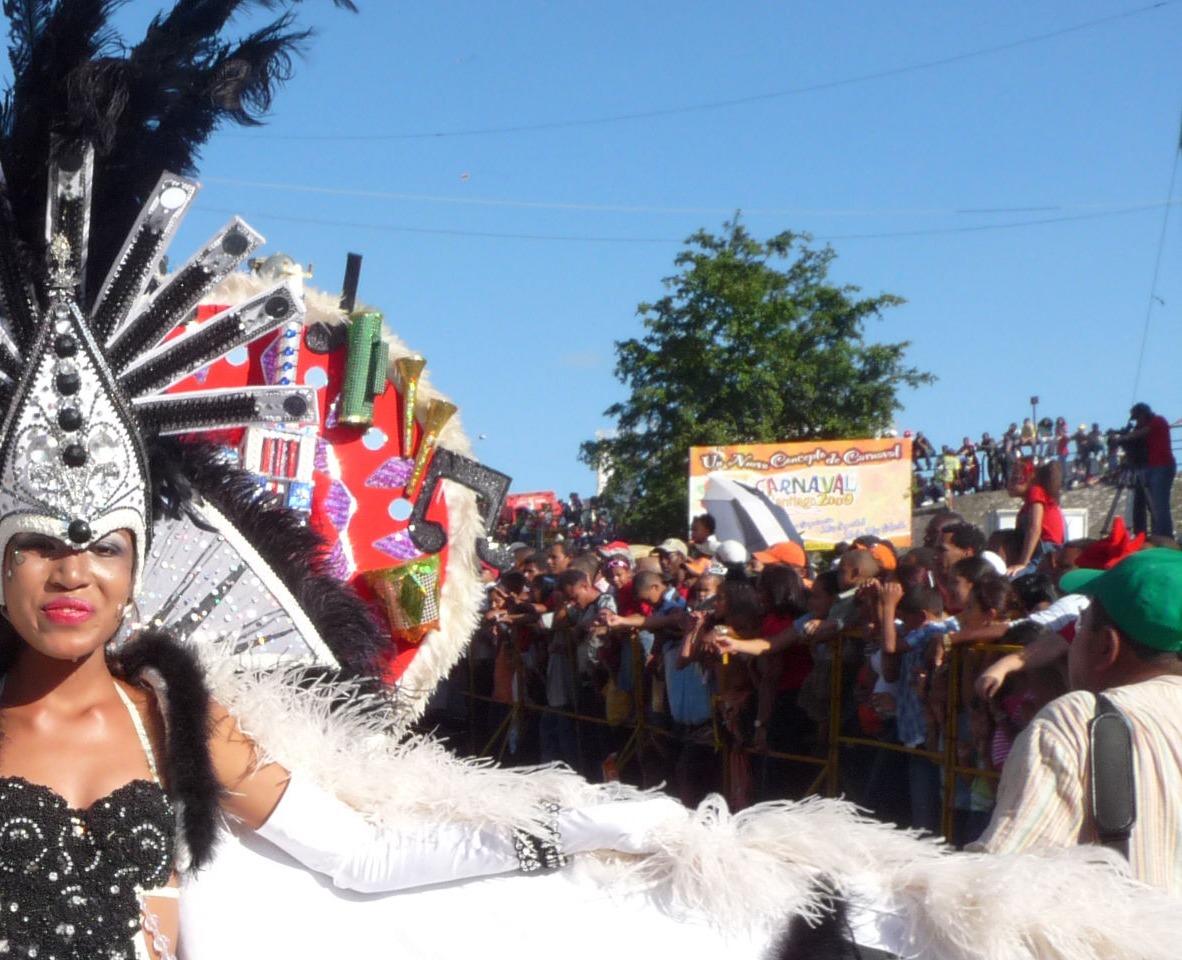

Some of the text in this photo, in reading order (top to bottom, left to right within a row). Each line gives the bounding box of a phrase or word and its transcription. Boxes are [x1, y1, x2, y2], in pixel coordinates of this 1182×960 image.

[770, 447, 826, 468] Concepto
[825, 450, 841, 465] de
[842, 444, 901, 465] Carnaval
